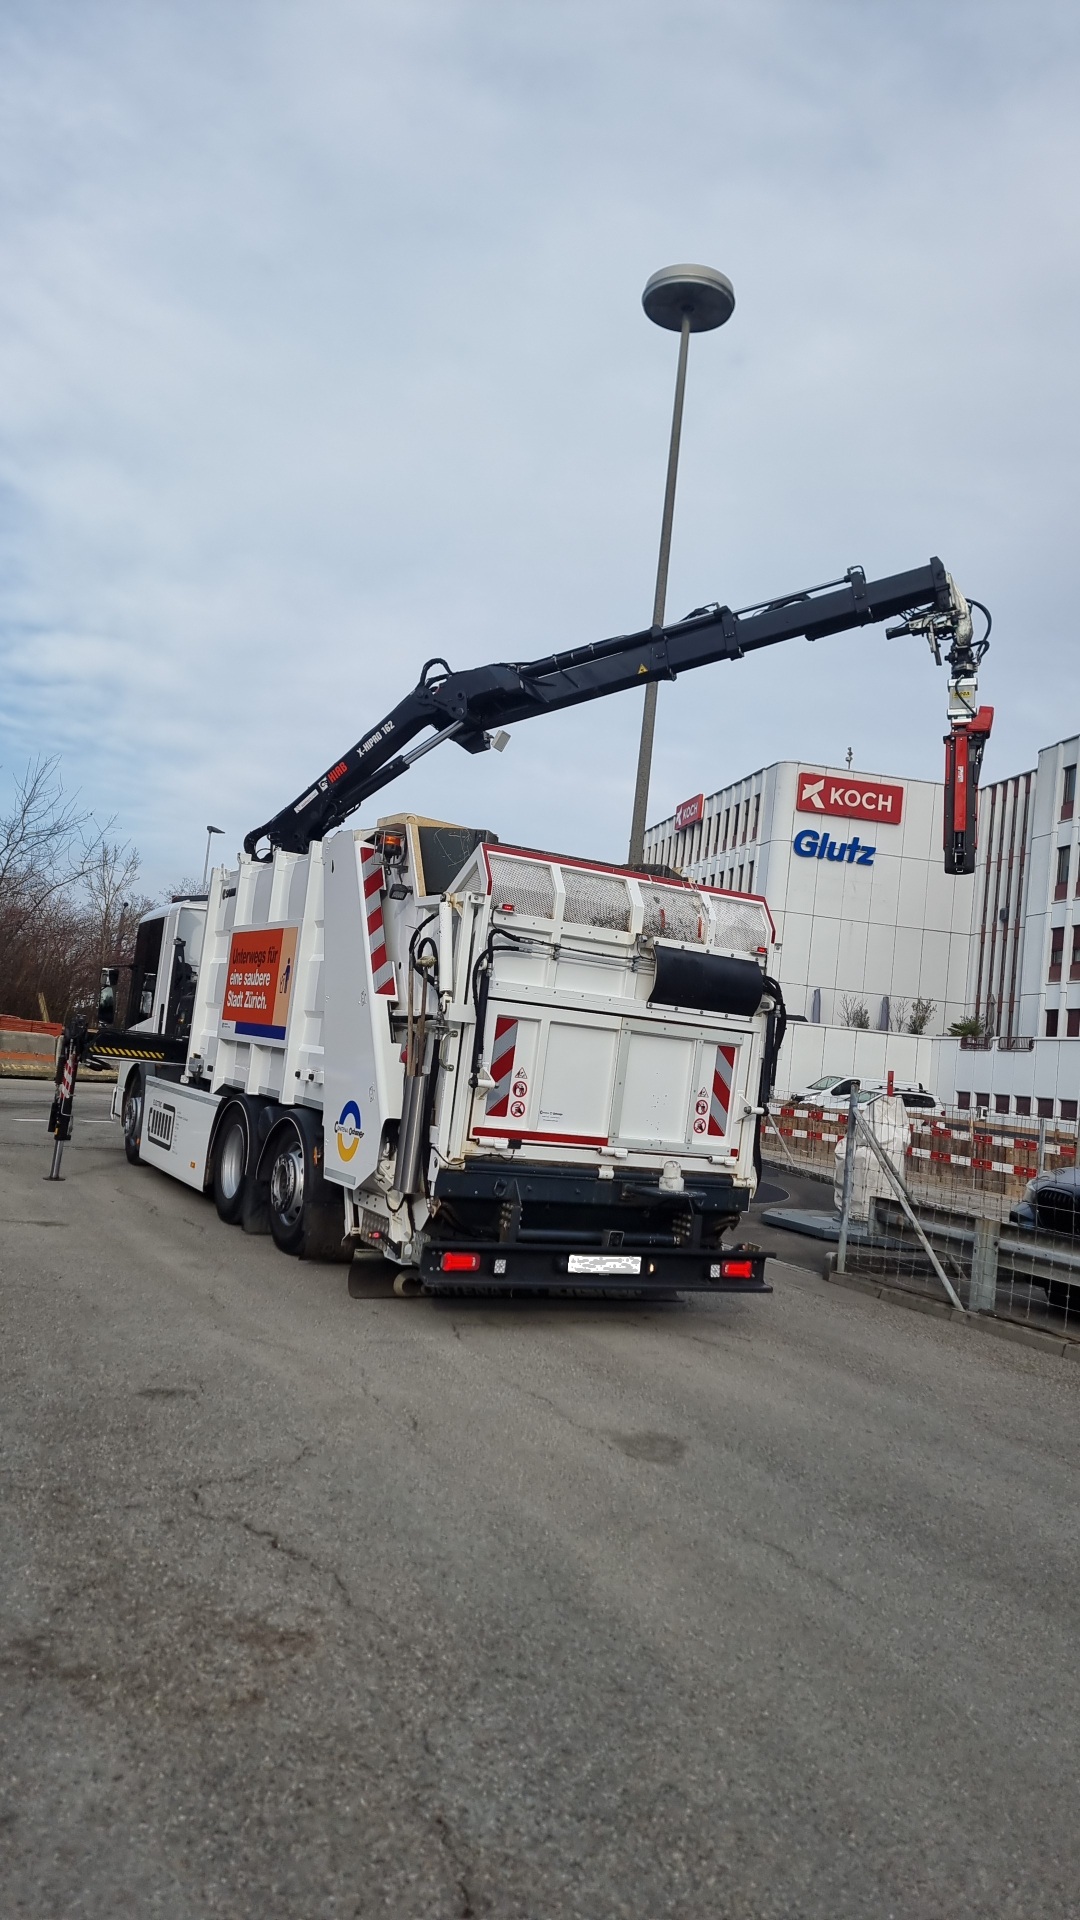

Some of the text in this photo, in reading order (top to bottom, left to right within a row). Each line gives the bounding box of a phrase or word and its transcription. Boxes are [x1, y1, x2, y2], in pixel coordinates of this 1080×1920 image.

[356, 720, 395, 757] X-HIPRO 162
[327, 761, 348, 784] HIAB
[829, 786, 894, 813] KOCH
[683, 801, 699, 821] KOCH
[793, 829, 877, 867] Glutz
[232, 946, 278, 967] Unterwegs für
[229, 968, 270, 986] eine saubere
[226, 990, 266, 1009] Stadt Zürich.
